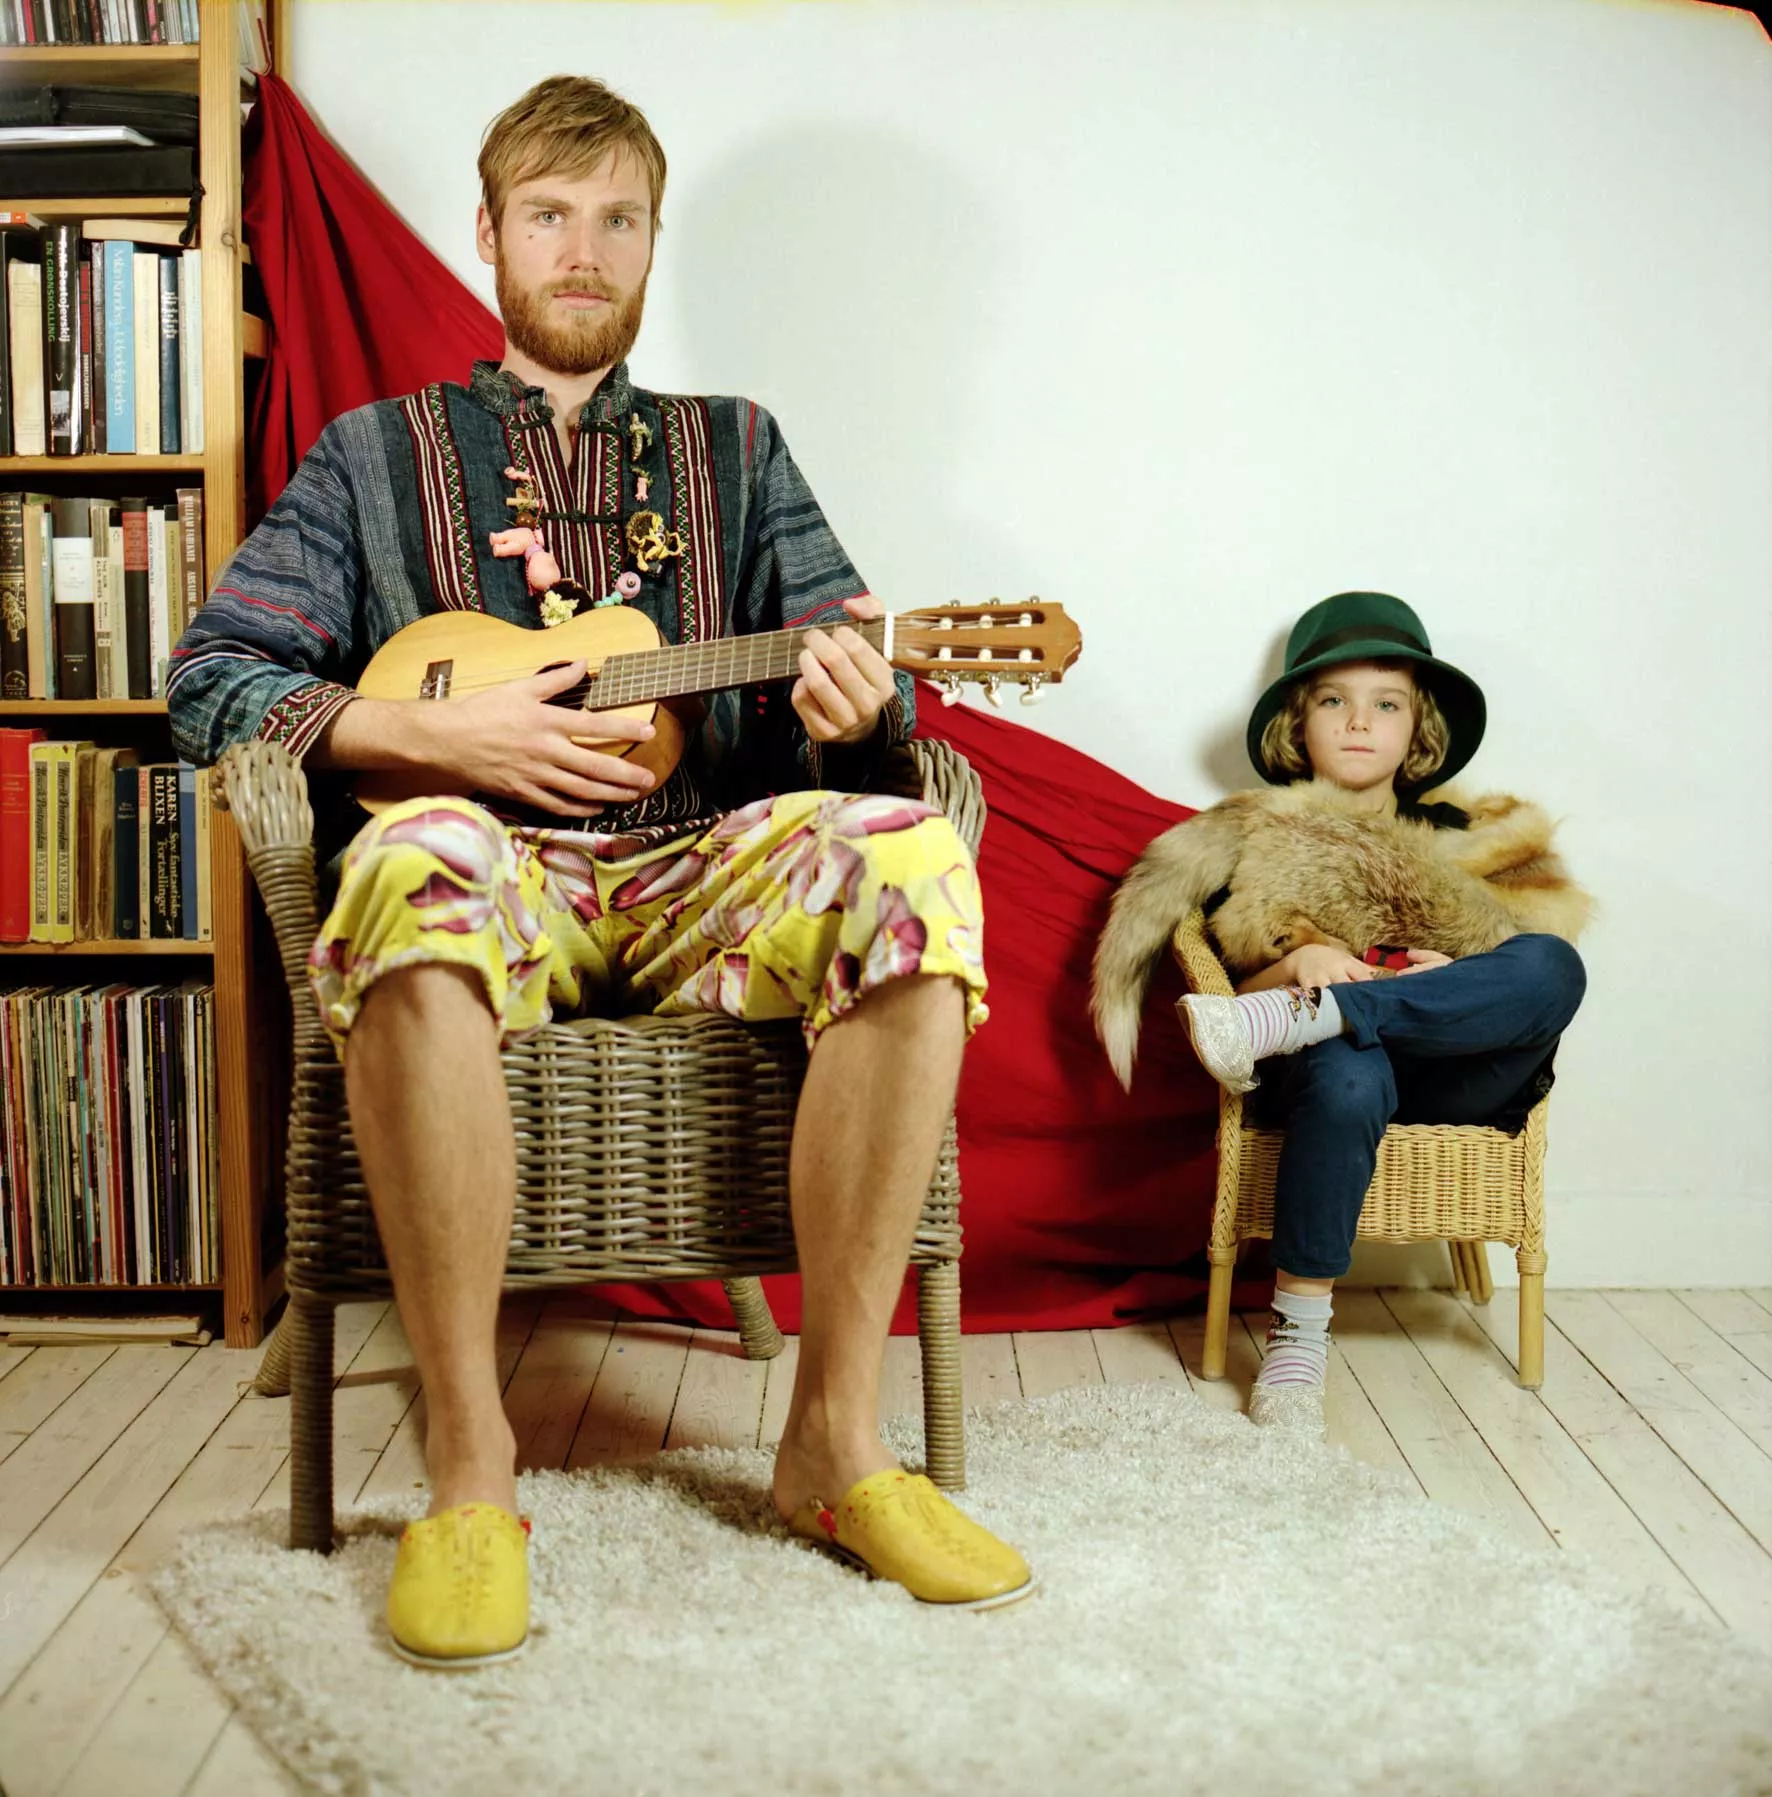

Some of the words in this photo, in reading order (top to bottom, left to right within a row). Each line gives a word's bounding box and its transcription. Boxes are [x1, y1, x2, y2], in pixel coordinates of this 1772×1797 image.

[46, 240, 53, 256] EN
[46, 258, 55, 342] GRØNSKOLLING
[58, 270, 70, 342] Dostojevskij
[183, 495, 195, 528] WILLIAM
[185, 528, 196, 562] FAULKNER
[154, 775, 165, 825] BLIXEN
[166, 775, 177, 821] KAREN
[169, 831, 179, 853] Syv
[154, 838, 169, 917] Fortællinger
[170, 854, 180, 918] fantastiske
